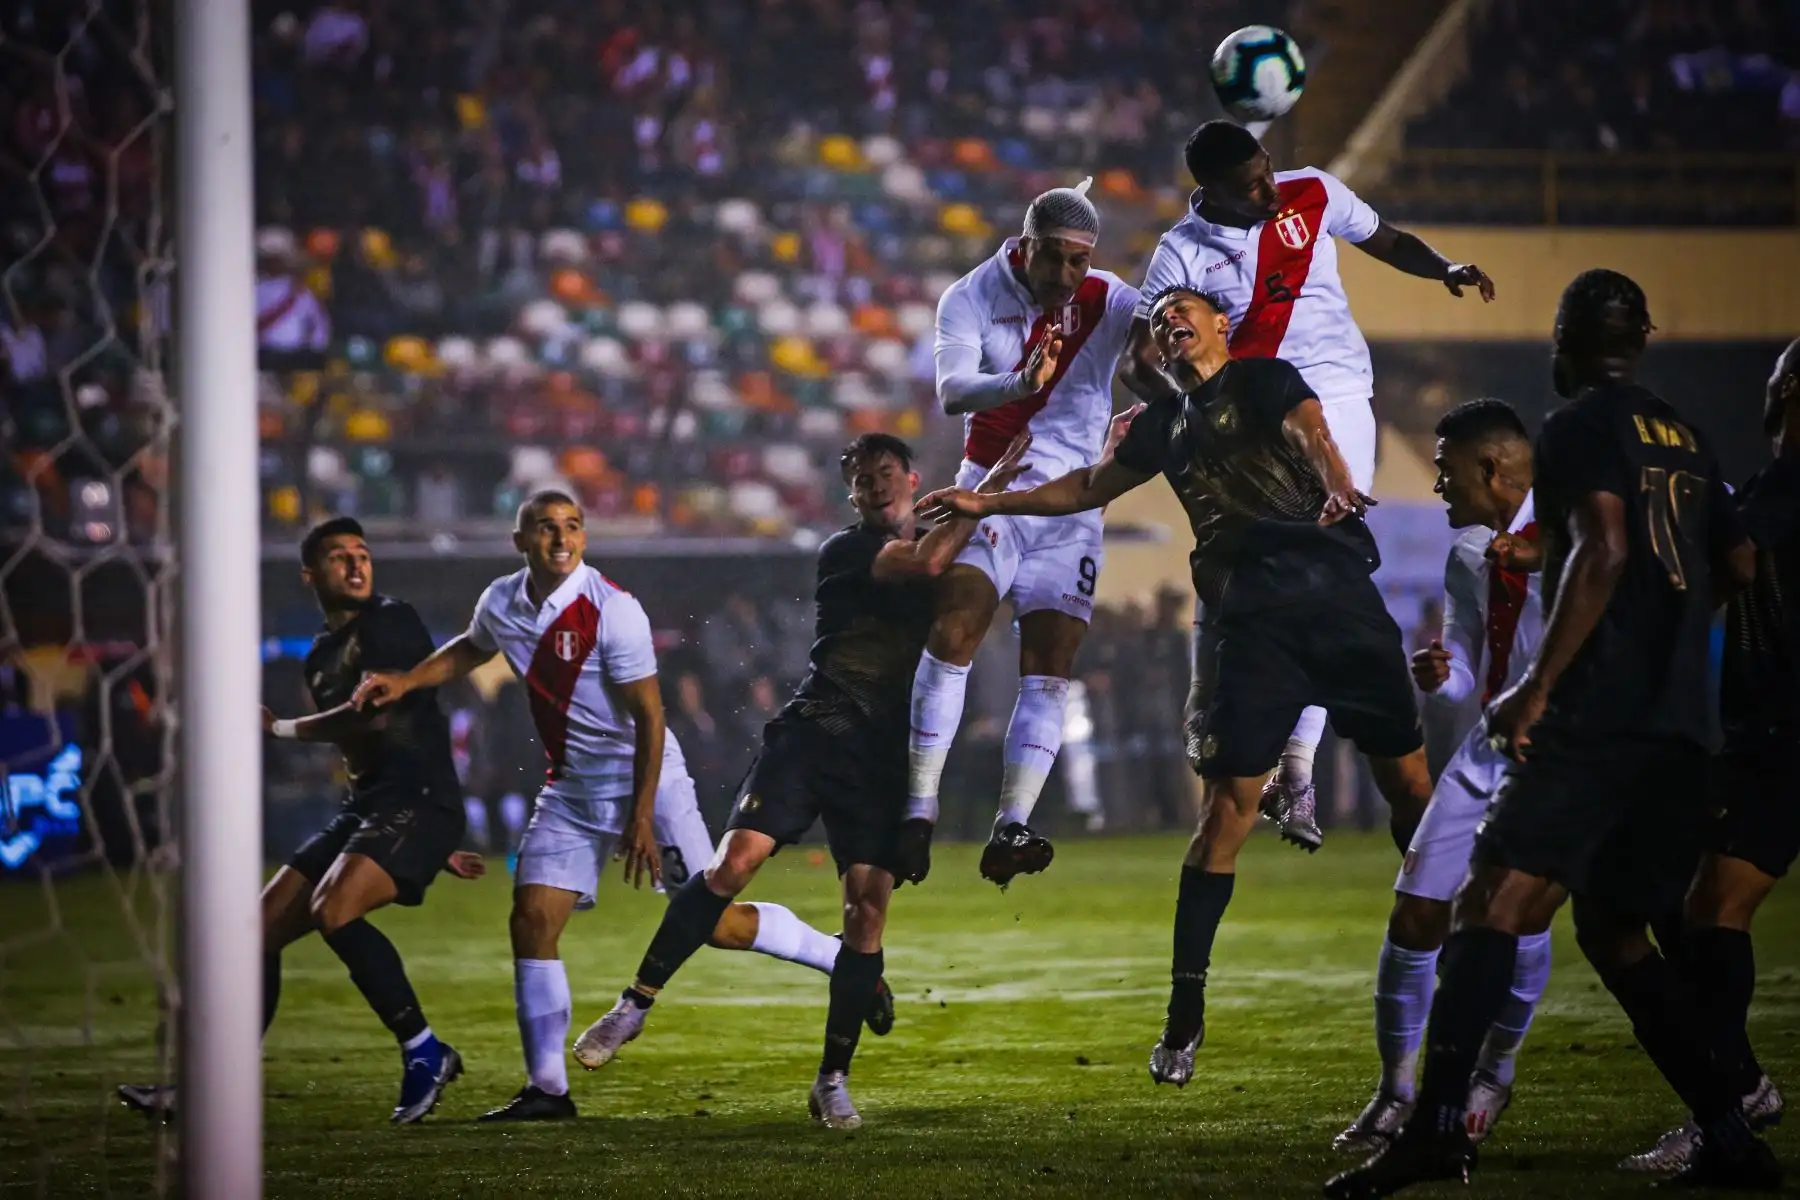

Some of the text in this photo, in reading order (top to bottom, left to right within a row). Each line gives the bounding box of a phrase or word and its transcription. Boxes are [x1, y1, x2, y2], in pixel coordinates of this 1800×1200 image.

[1206, 250, 1247, 275] maraon
[1264, 270, 1292, 302] 5
[1077, 555, 1097, 597] 9
[662, 845, 690, 884] 3
